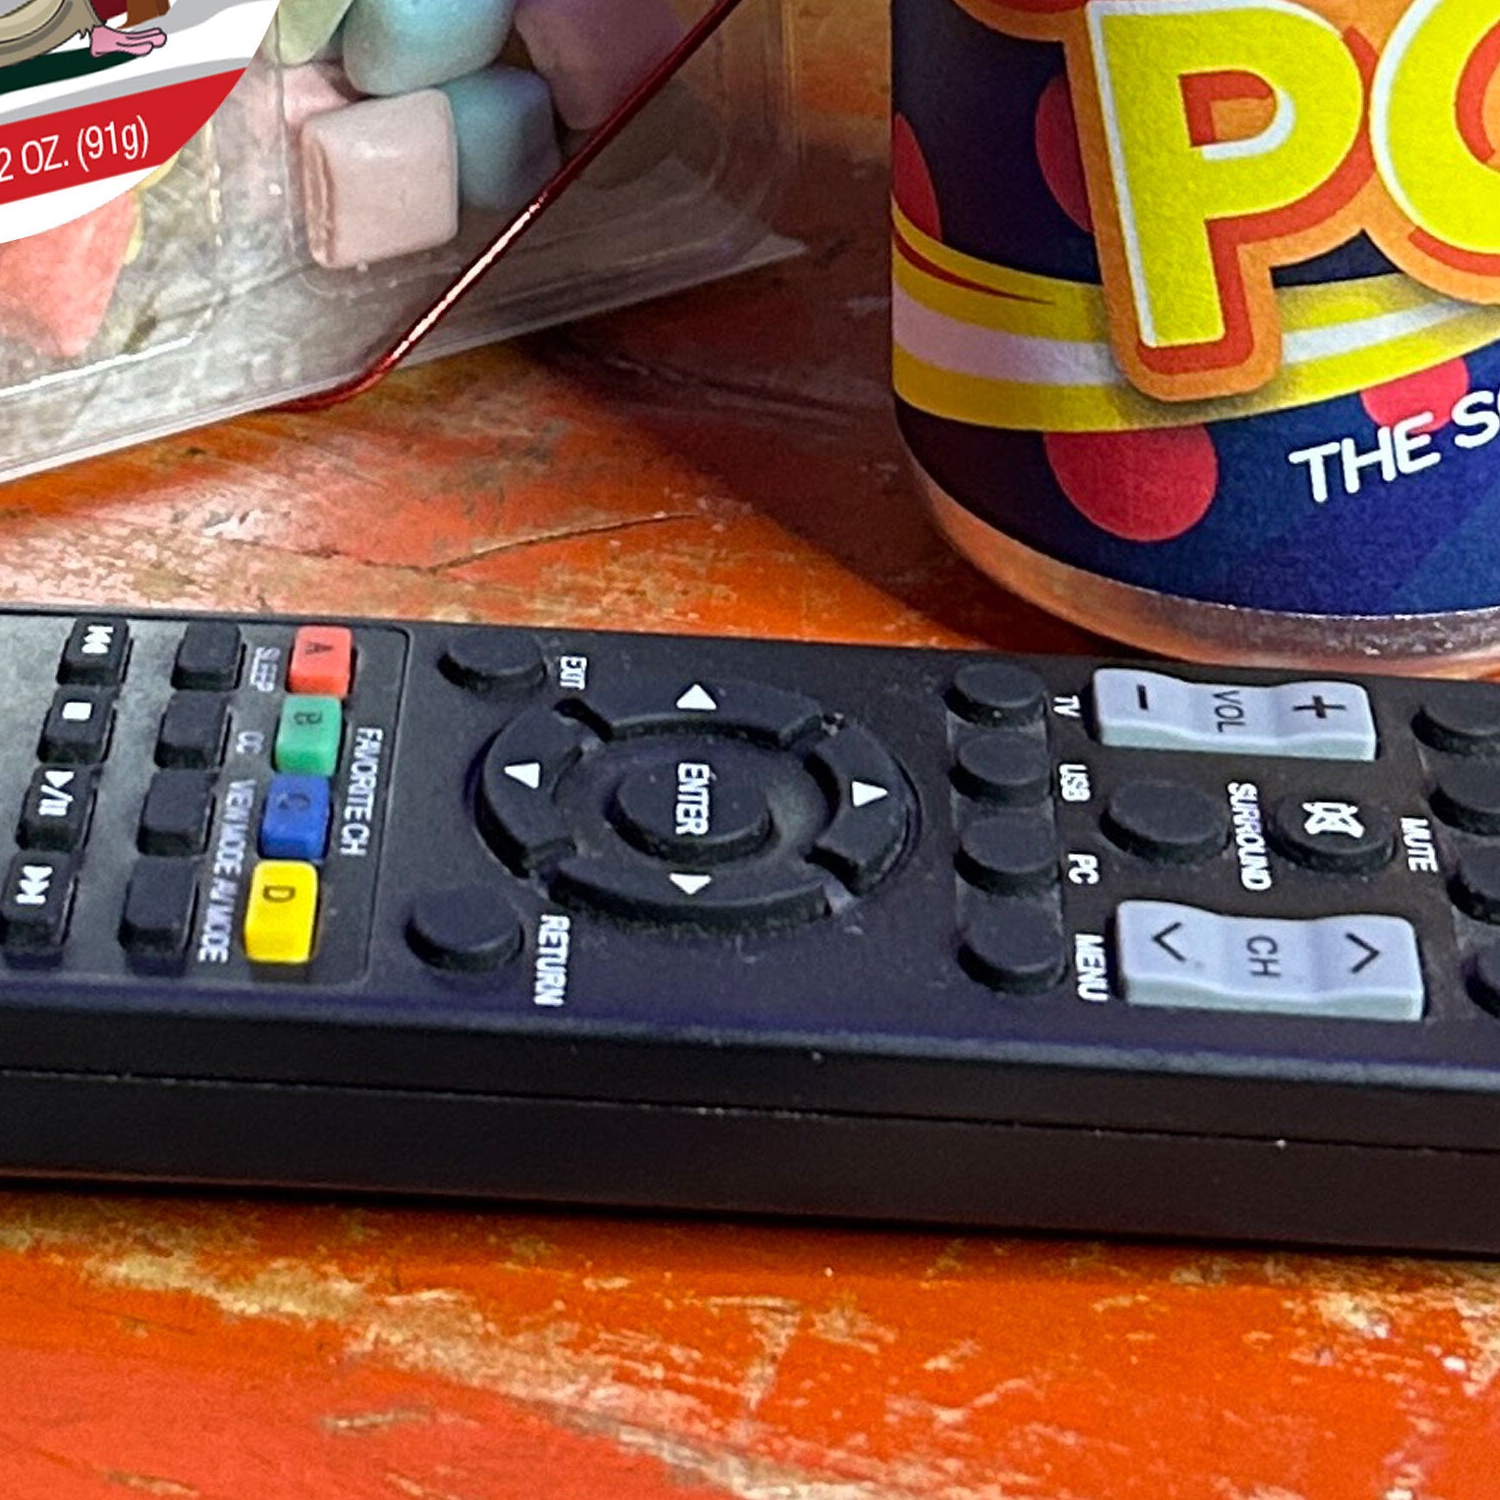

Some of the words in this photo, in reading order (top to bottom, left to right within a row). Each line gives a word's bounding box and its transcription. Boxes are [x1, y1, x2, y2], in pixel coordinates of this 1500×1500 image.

[21, 135, 69, 176] OZ.
[76, 115, 150, 172] (91g)
[1288, 411, 1441, 502] THE
[1451, 385, 1500, 449] S
[305, 641, 333, 655] A
[249, 647, 280, 692] SLEEP
[559, 656, 587, 690] EXIT
[295, 711, 323, 727] B
[1053, 695, 1080, 717] TV
[1211, 690, 1245, 733] VOL
[237, 731, 265, 754] CC
[345, 727, 383, 822] FAVORITE
[1059, 763, 1091, 802] USB
[223, 779, 257, 820] VIEW
[676, 762, 710, 835] ENTER
[213, 820, 248, 875] MODE
[339, 822, 372, 856] CH
[1227, 782, 1272, 891] SURROUND
[1400, 817, 1439, 874] MUTE
[1067, 852, 1099, 885] PC
[208, 877, 238, 906] AV
[263, 884, 296, 902] D
[199, 906, 235, 963] MODE
[534, 914, 571, 1006] RETURN
[1074, 932, 1108, 1002] MENU
[1245, 936, 1281, 978] CH
